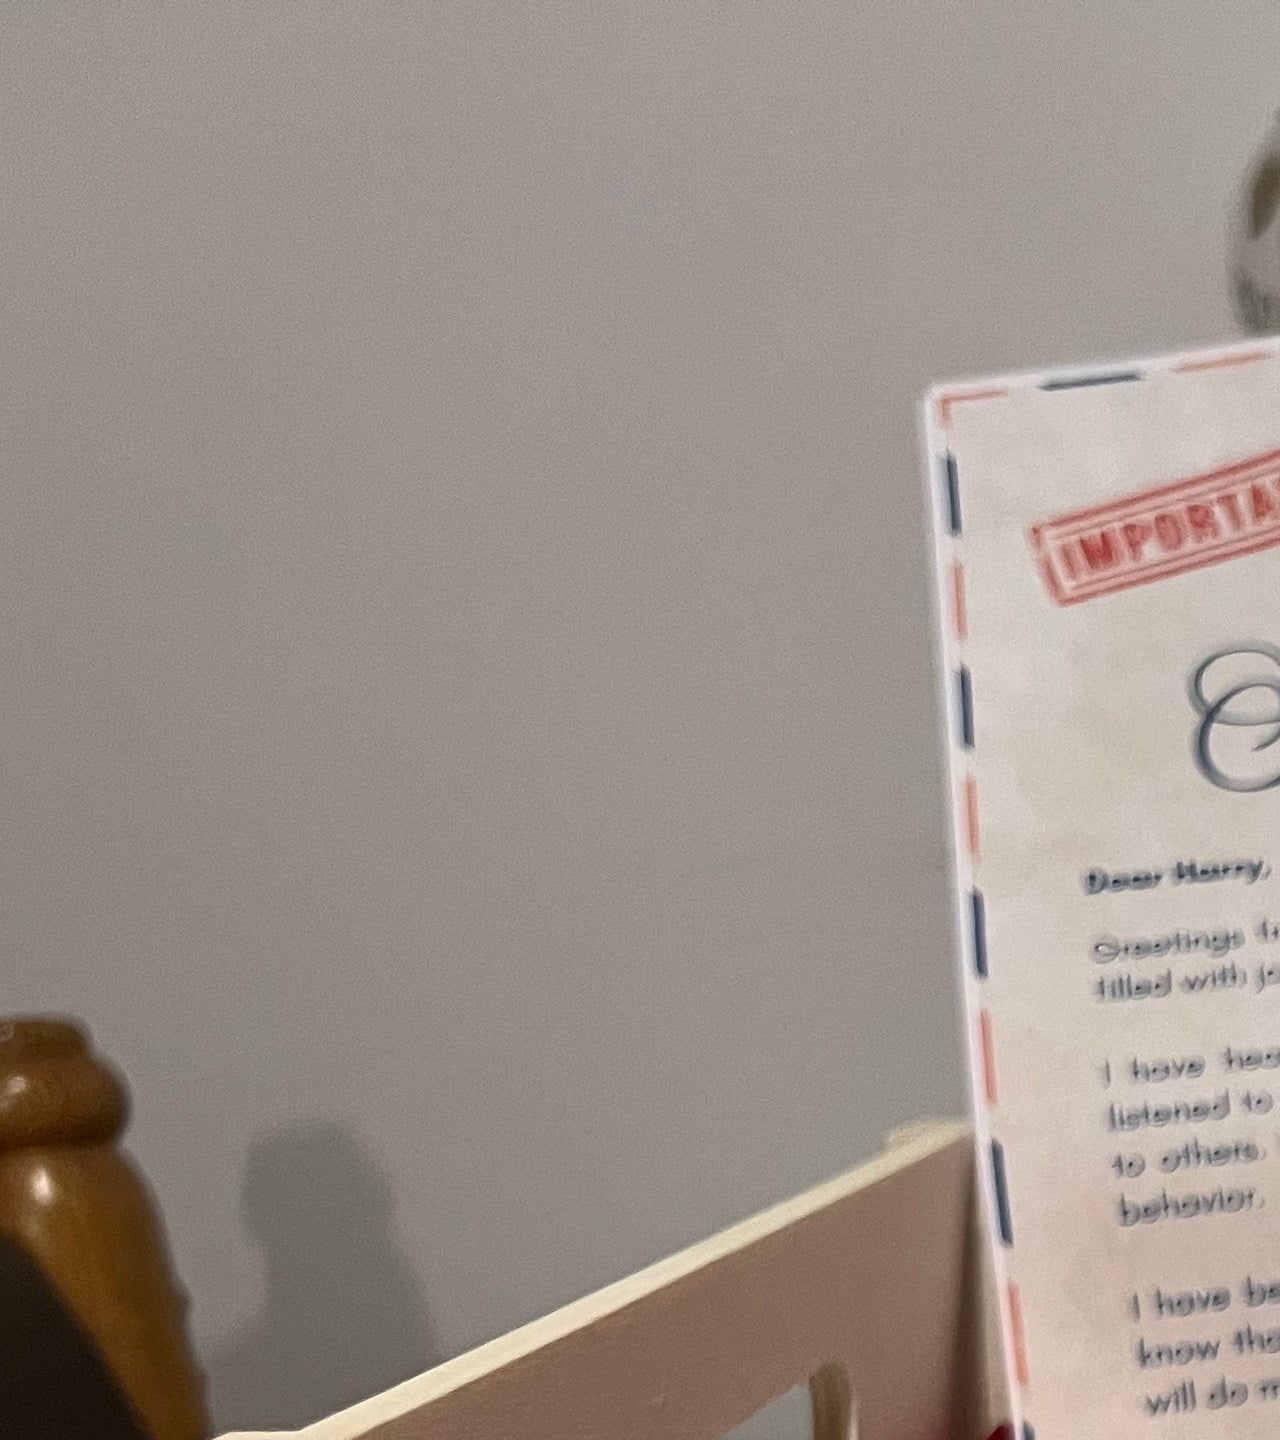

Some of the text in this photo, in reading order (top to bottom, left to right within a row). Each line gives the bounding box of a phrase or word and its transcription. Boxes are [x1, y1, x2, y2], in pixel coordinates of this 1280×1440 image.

[1090, 930, 1246, 966] Greetings
[1091, 967, 1172, 1001] filled
[1179, 964, 1247, 995] with
[1130, 1054, 1206, 1085] have
[1107, 1089, 1231, 1133] listened
[1240, 1091, 1274, 1114] to
[1111, 1152, 1146, 1180] to
[1151, 1284, 1232, 1319] have
[1132, 1334, 1222, 1370] know
[1142, 1379, 1197, 1418] will
[1205, 1376, 1250, 1409] do
